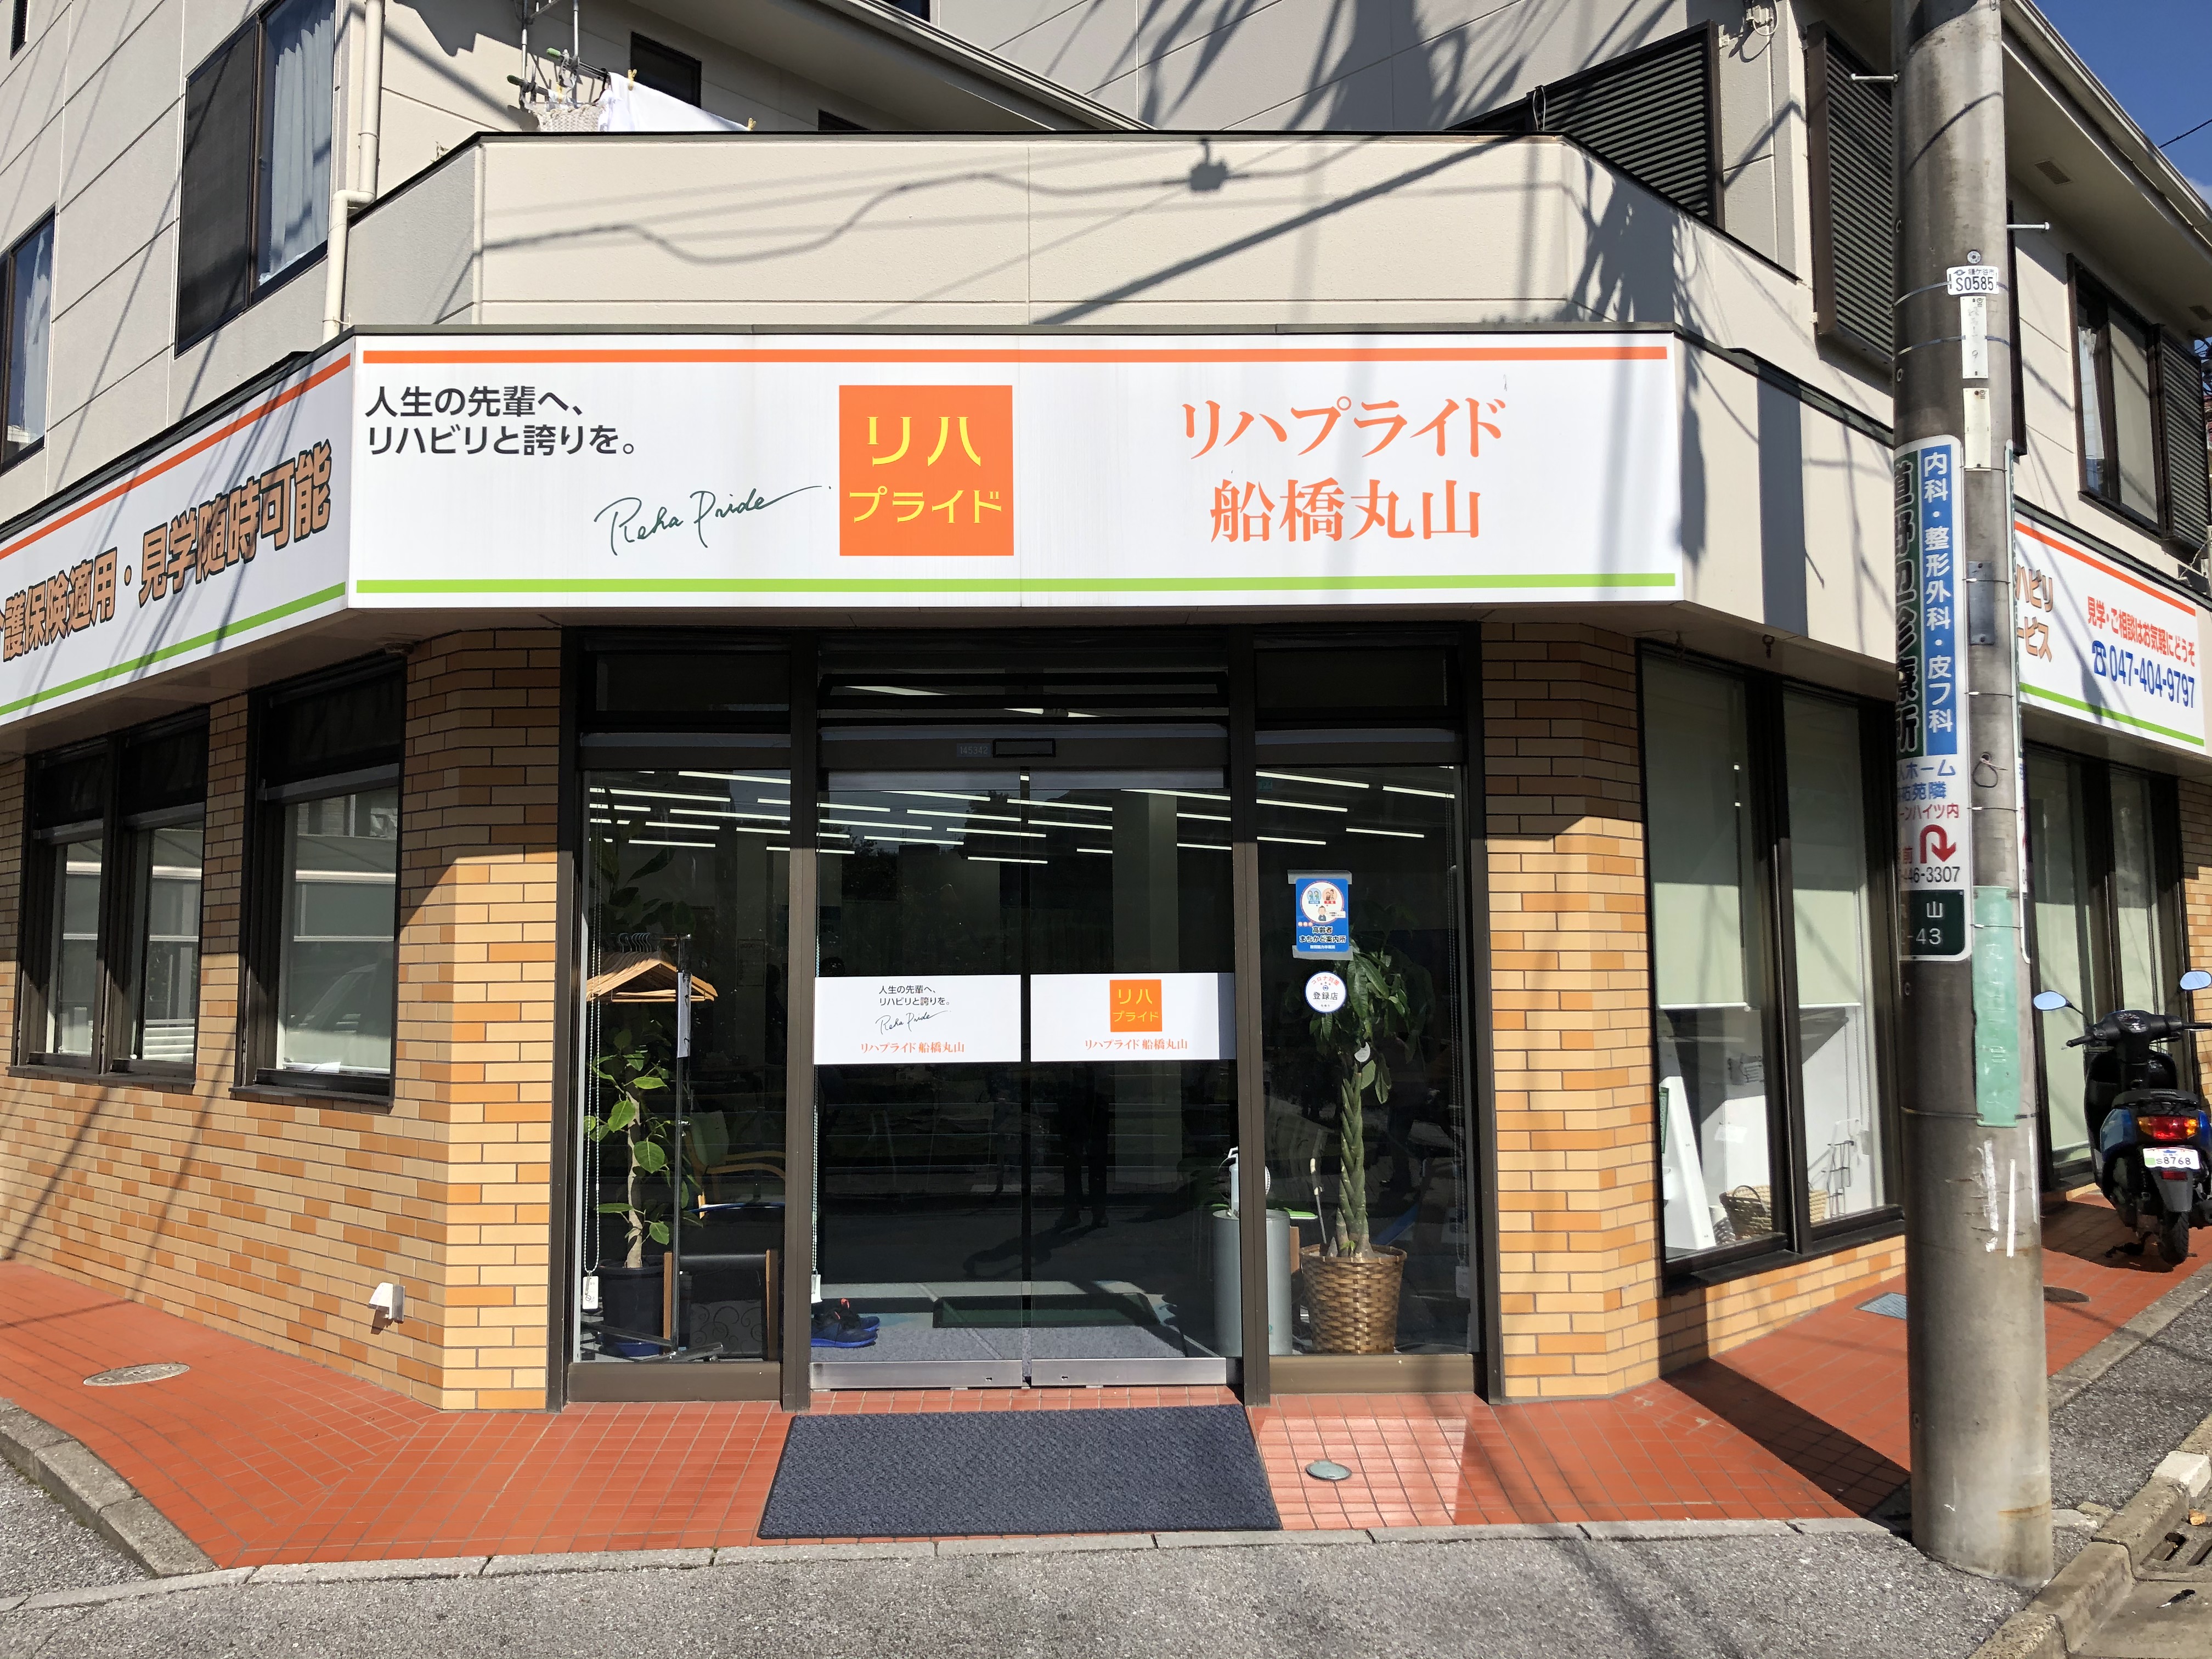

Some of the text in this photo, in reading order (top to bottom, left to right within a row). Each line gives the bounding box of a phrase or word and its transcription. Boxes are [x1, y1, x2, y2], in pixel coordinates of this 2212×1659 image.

[1956, 276, 1994, 291] S0585
[365, 386, 583, 417] 人生の先輩へ、
[368, 424, 635, 456] リハビリと誇りを。
[866, 416, 982, 467] リハ
[1182, 396, 1506, 460] リハプライド
[594, 485, 834, 556] Reha Pride
[849, 486, 1003, 524] プライド
[1210, 477, 1481, 543] 船橋丸山
[0, 438, 332, 663] 護保険適用・見学随時可能
[2109, 645, 2194, 708] 047-404-9797
[879, 985, 936, 994] 人生の先輩へ、
[879, 997, 950, 1006] リハビリと誇りを。
[1118, 989, 1153, 1005] リハ
[1313, 991, 1339, 1000] 登録店
[1113, 1010, 1159, 1022] プライド
[861, 1041, 965, 1054] リハプライド 船橋丸山
[1085, 1038, 1188, 1051] リハプライド 船橋丸山
